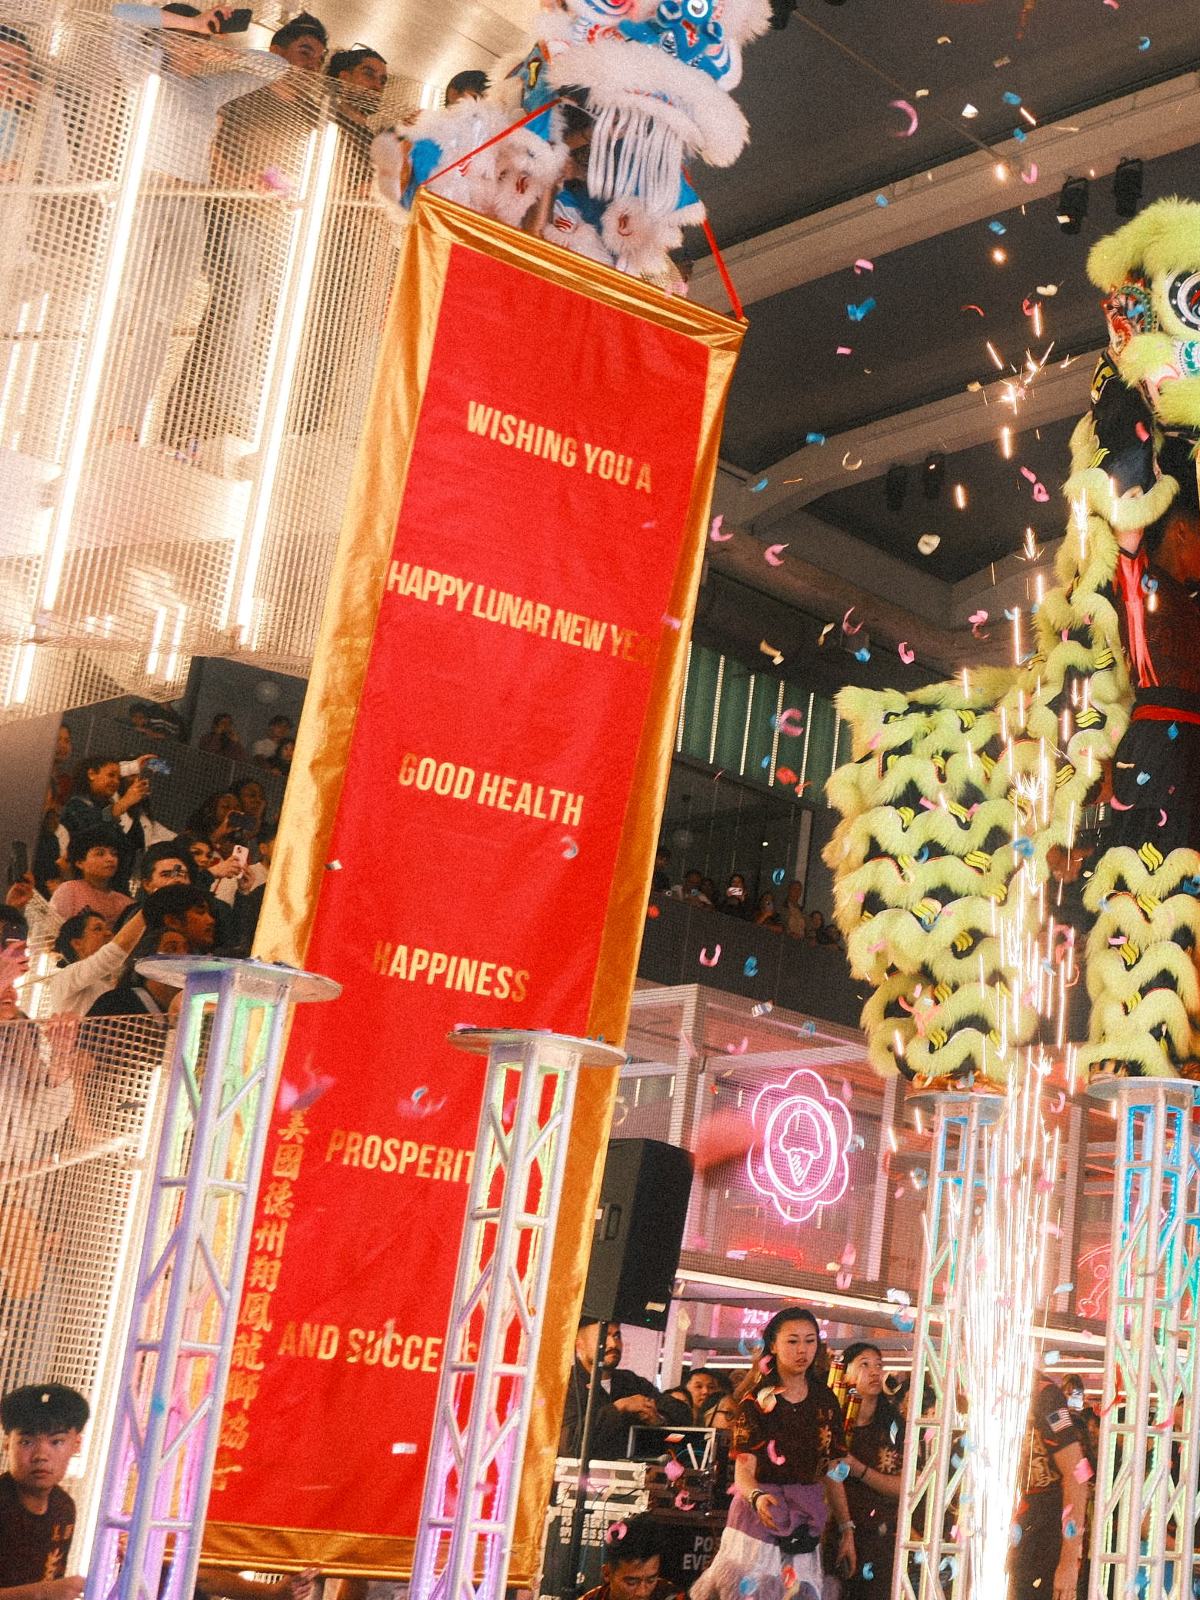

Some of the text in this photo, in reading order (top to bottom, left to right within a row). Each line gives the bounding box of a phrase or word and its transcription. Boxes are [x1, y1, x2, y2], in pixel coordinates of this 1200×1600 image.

[467, 400, 651, 494] WISHING YOU A
[386, 560, 648, 664] HAPPY LUNAR NEW YE
[399, 752, 585, 827] GOOD HEALTH
[372, 939, 530, 1004] HAPPINESS
[325, 1129, 476, 1185] PROSPERIT
[277, 1321, 477, 1373] AND SUCCE
